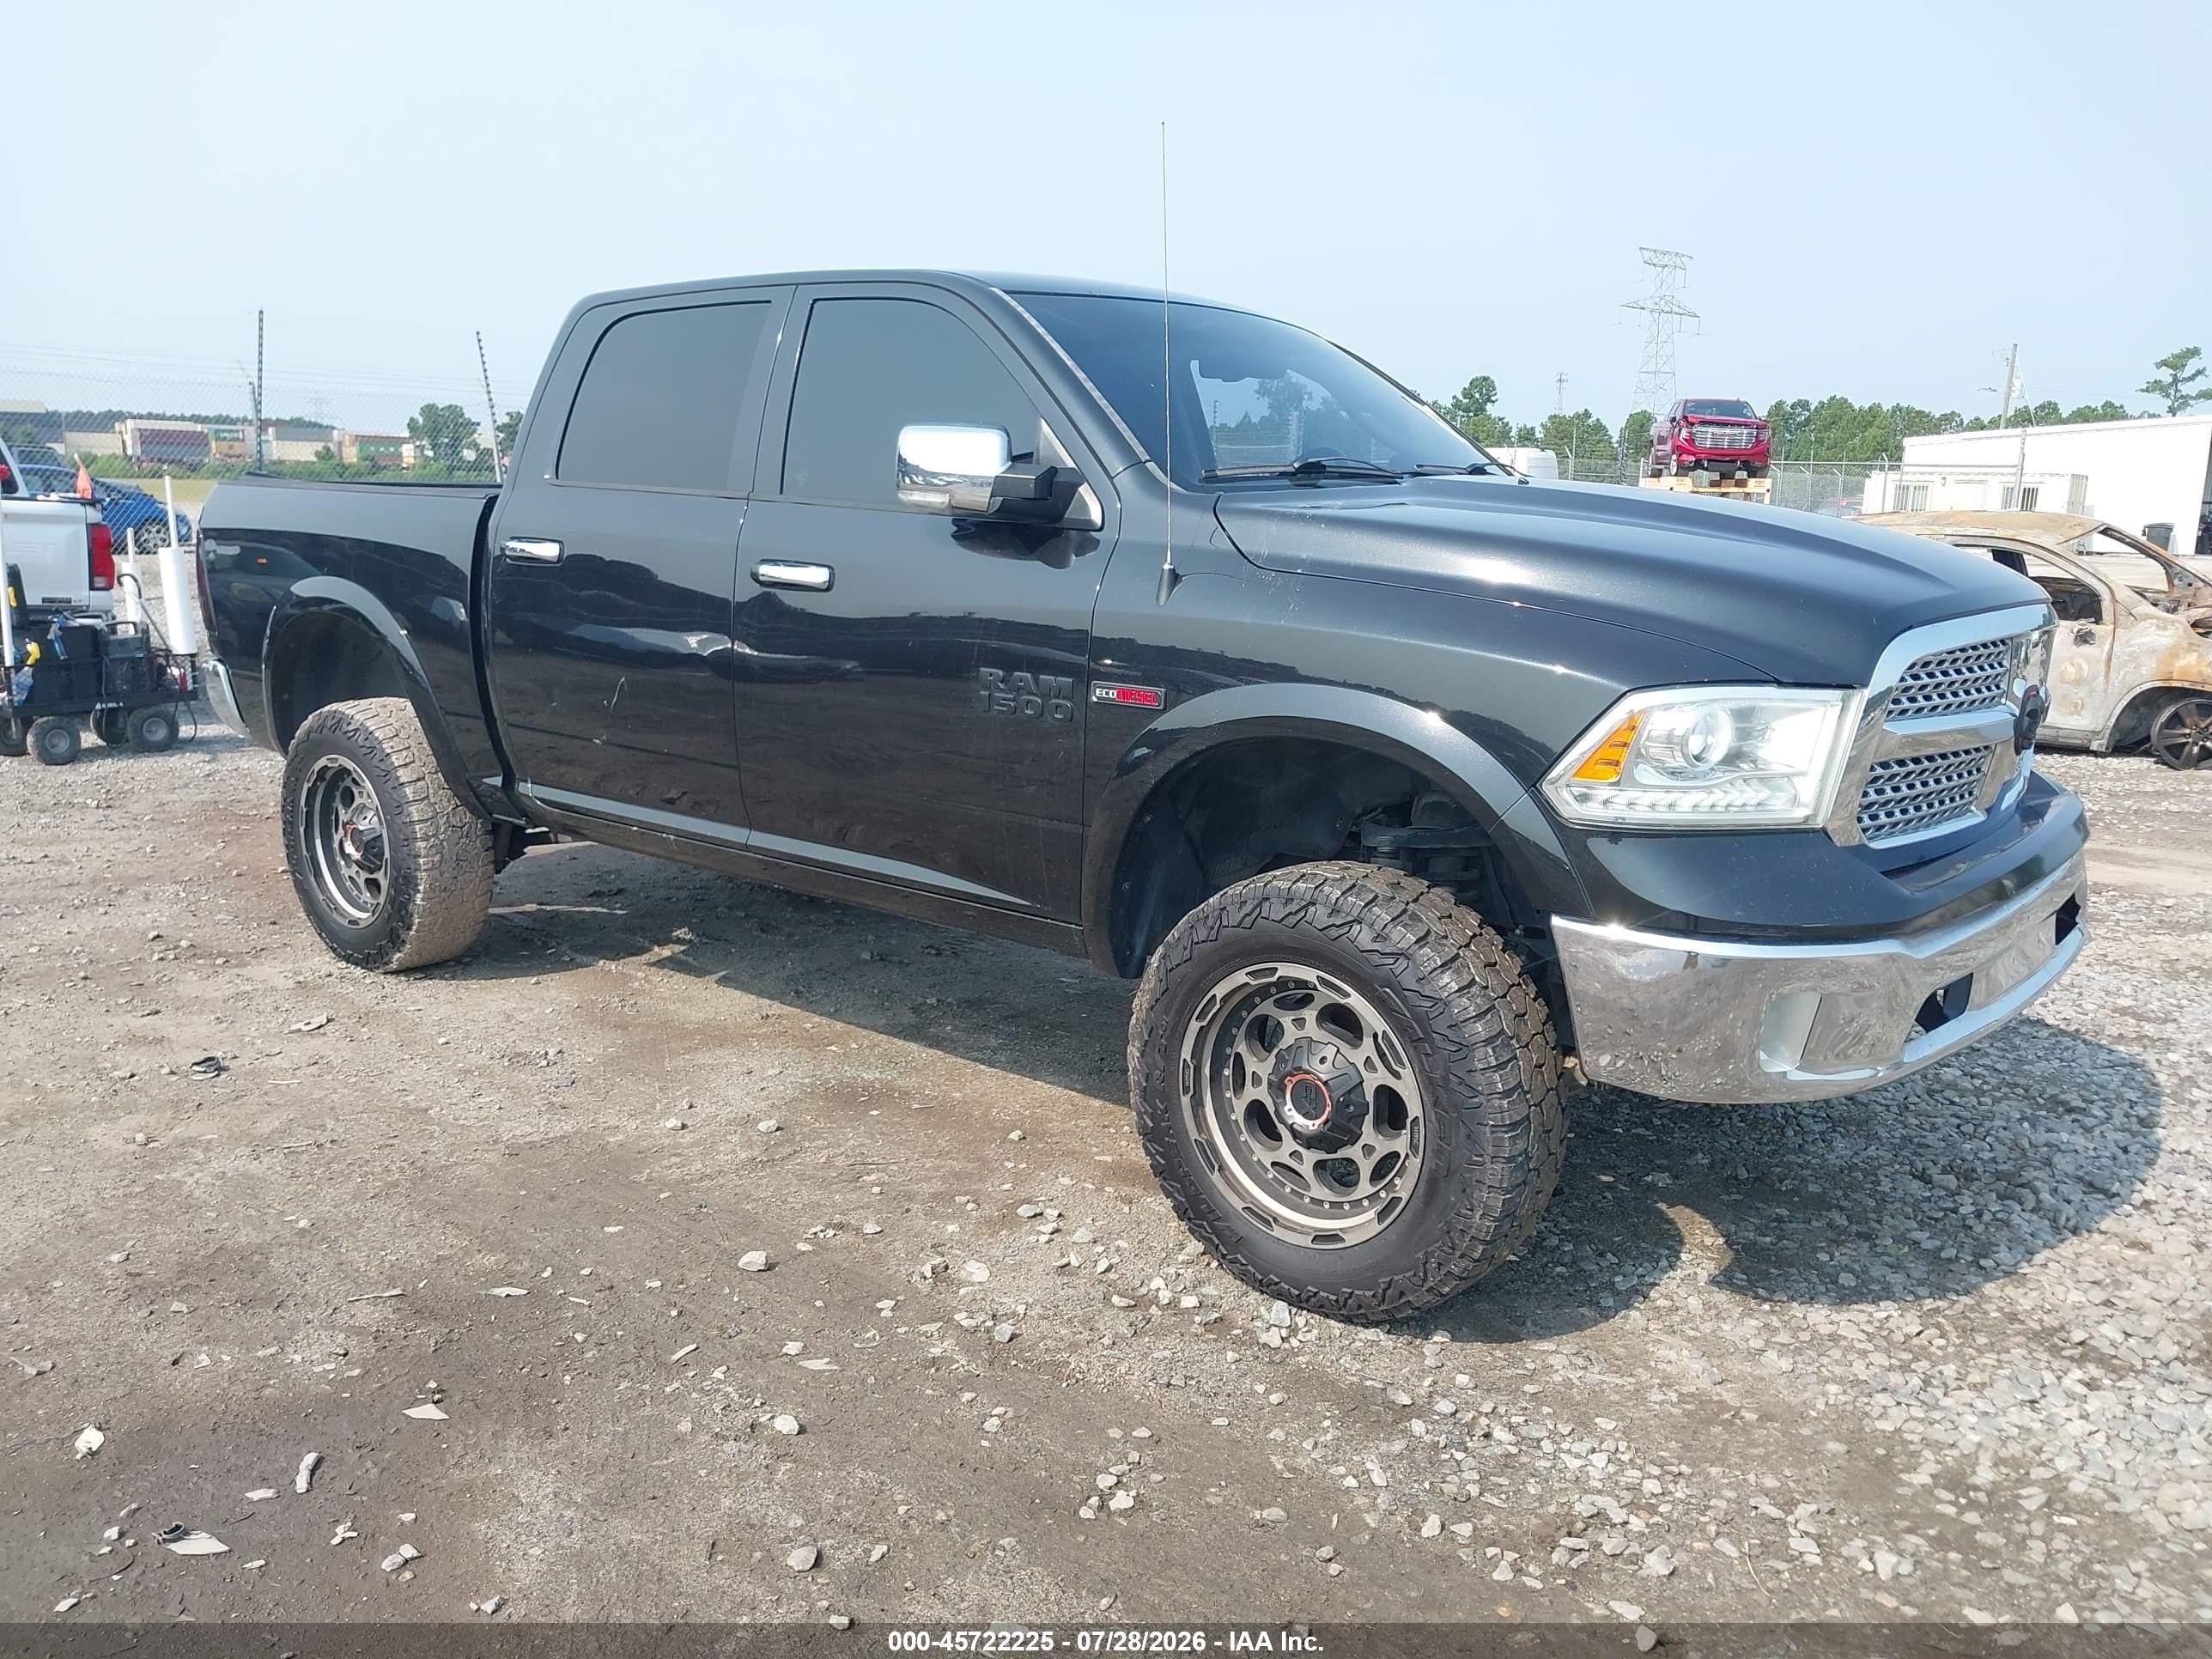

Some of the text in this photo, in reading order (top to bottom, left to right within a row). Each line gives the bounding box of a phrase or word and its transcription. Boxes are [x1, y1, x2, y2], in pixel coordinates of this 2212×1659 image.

[979, 667, 1073, 700] RAM
[1096, 688, 1159, 706] ECODIESEL
[979, 690, 1073, 722] 1500
